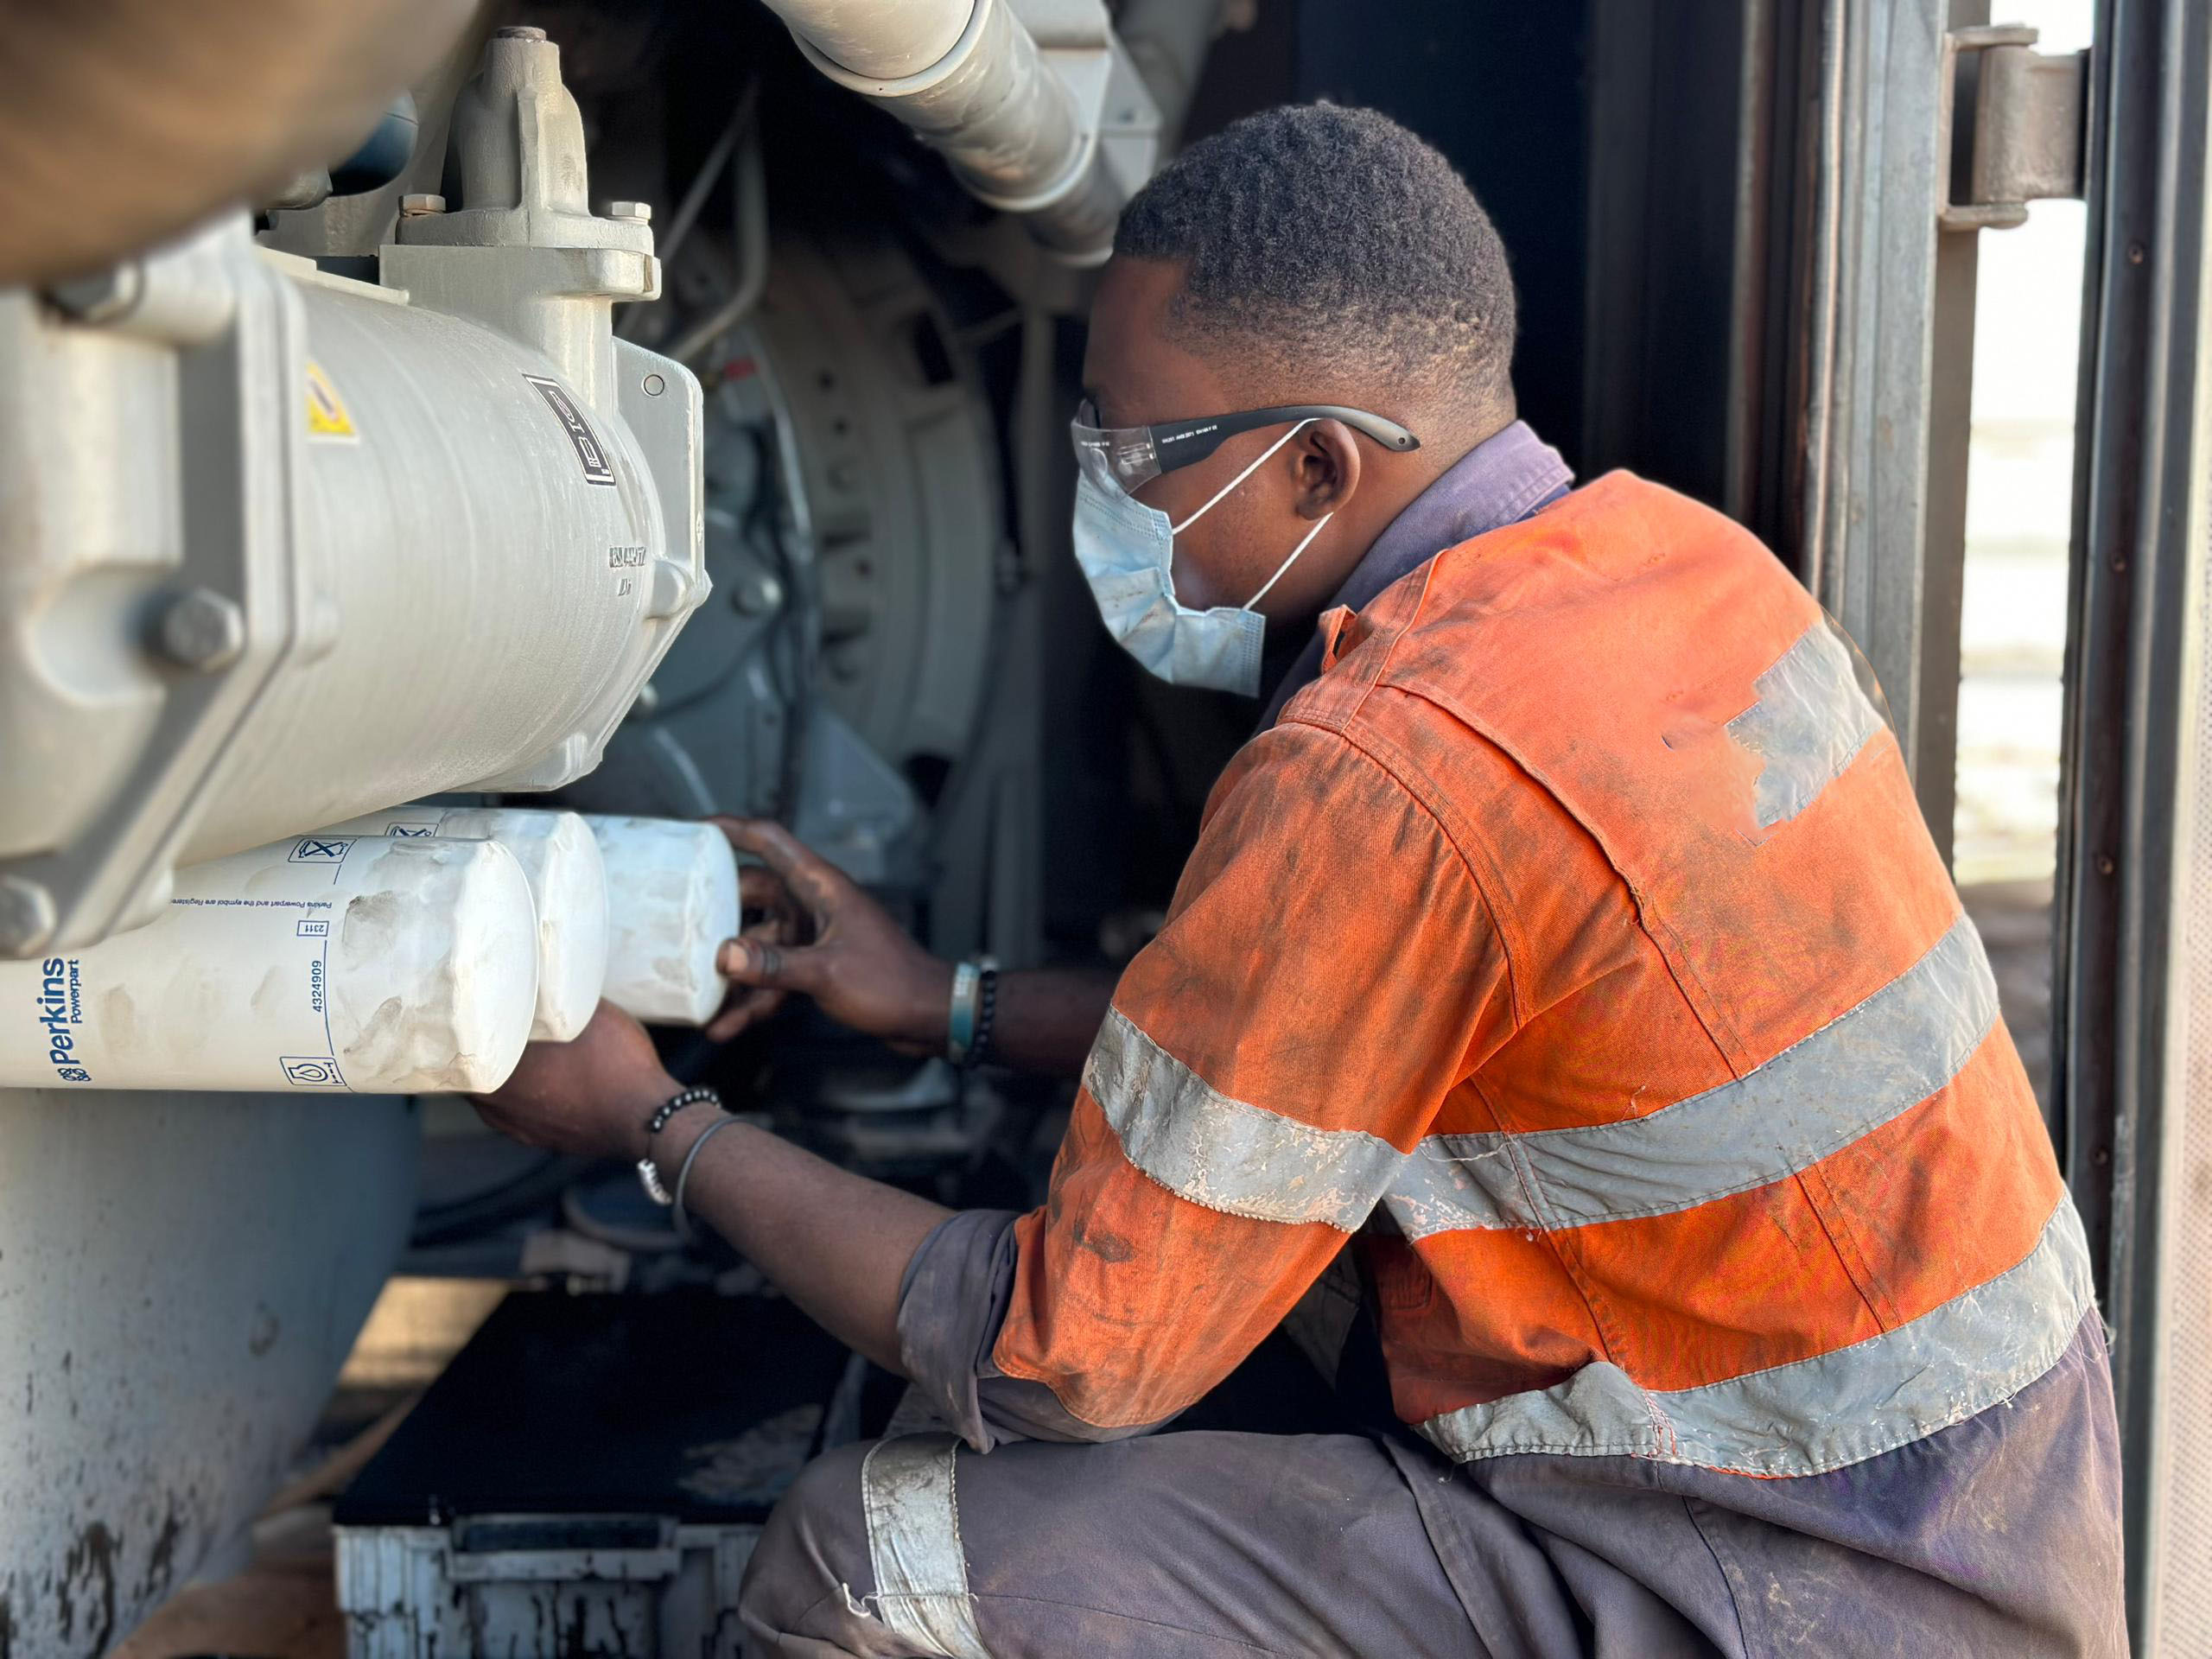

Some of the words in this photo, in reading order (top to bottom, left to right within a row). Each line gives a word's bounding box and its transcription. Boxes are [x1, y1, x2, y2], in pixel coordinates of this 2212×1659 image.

[304, 925, 325, 933] 2311
[36, 957, 81, 1065] Perkins
[67, 959, 83, 1024] Powerpart
[311, 960, 322, 1013] 4324909
